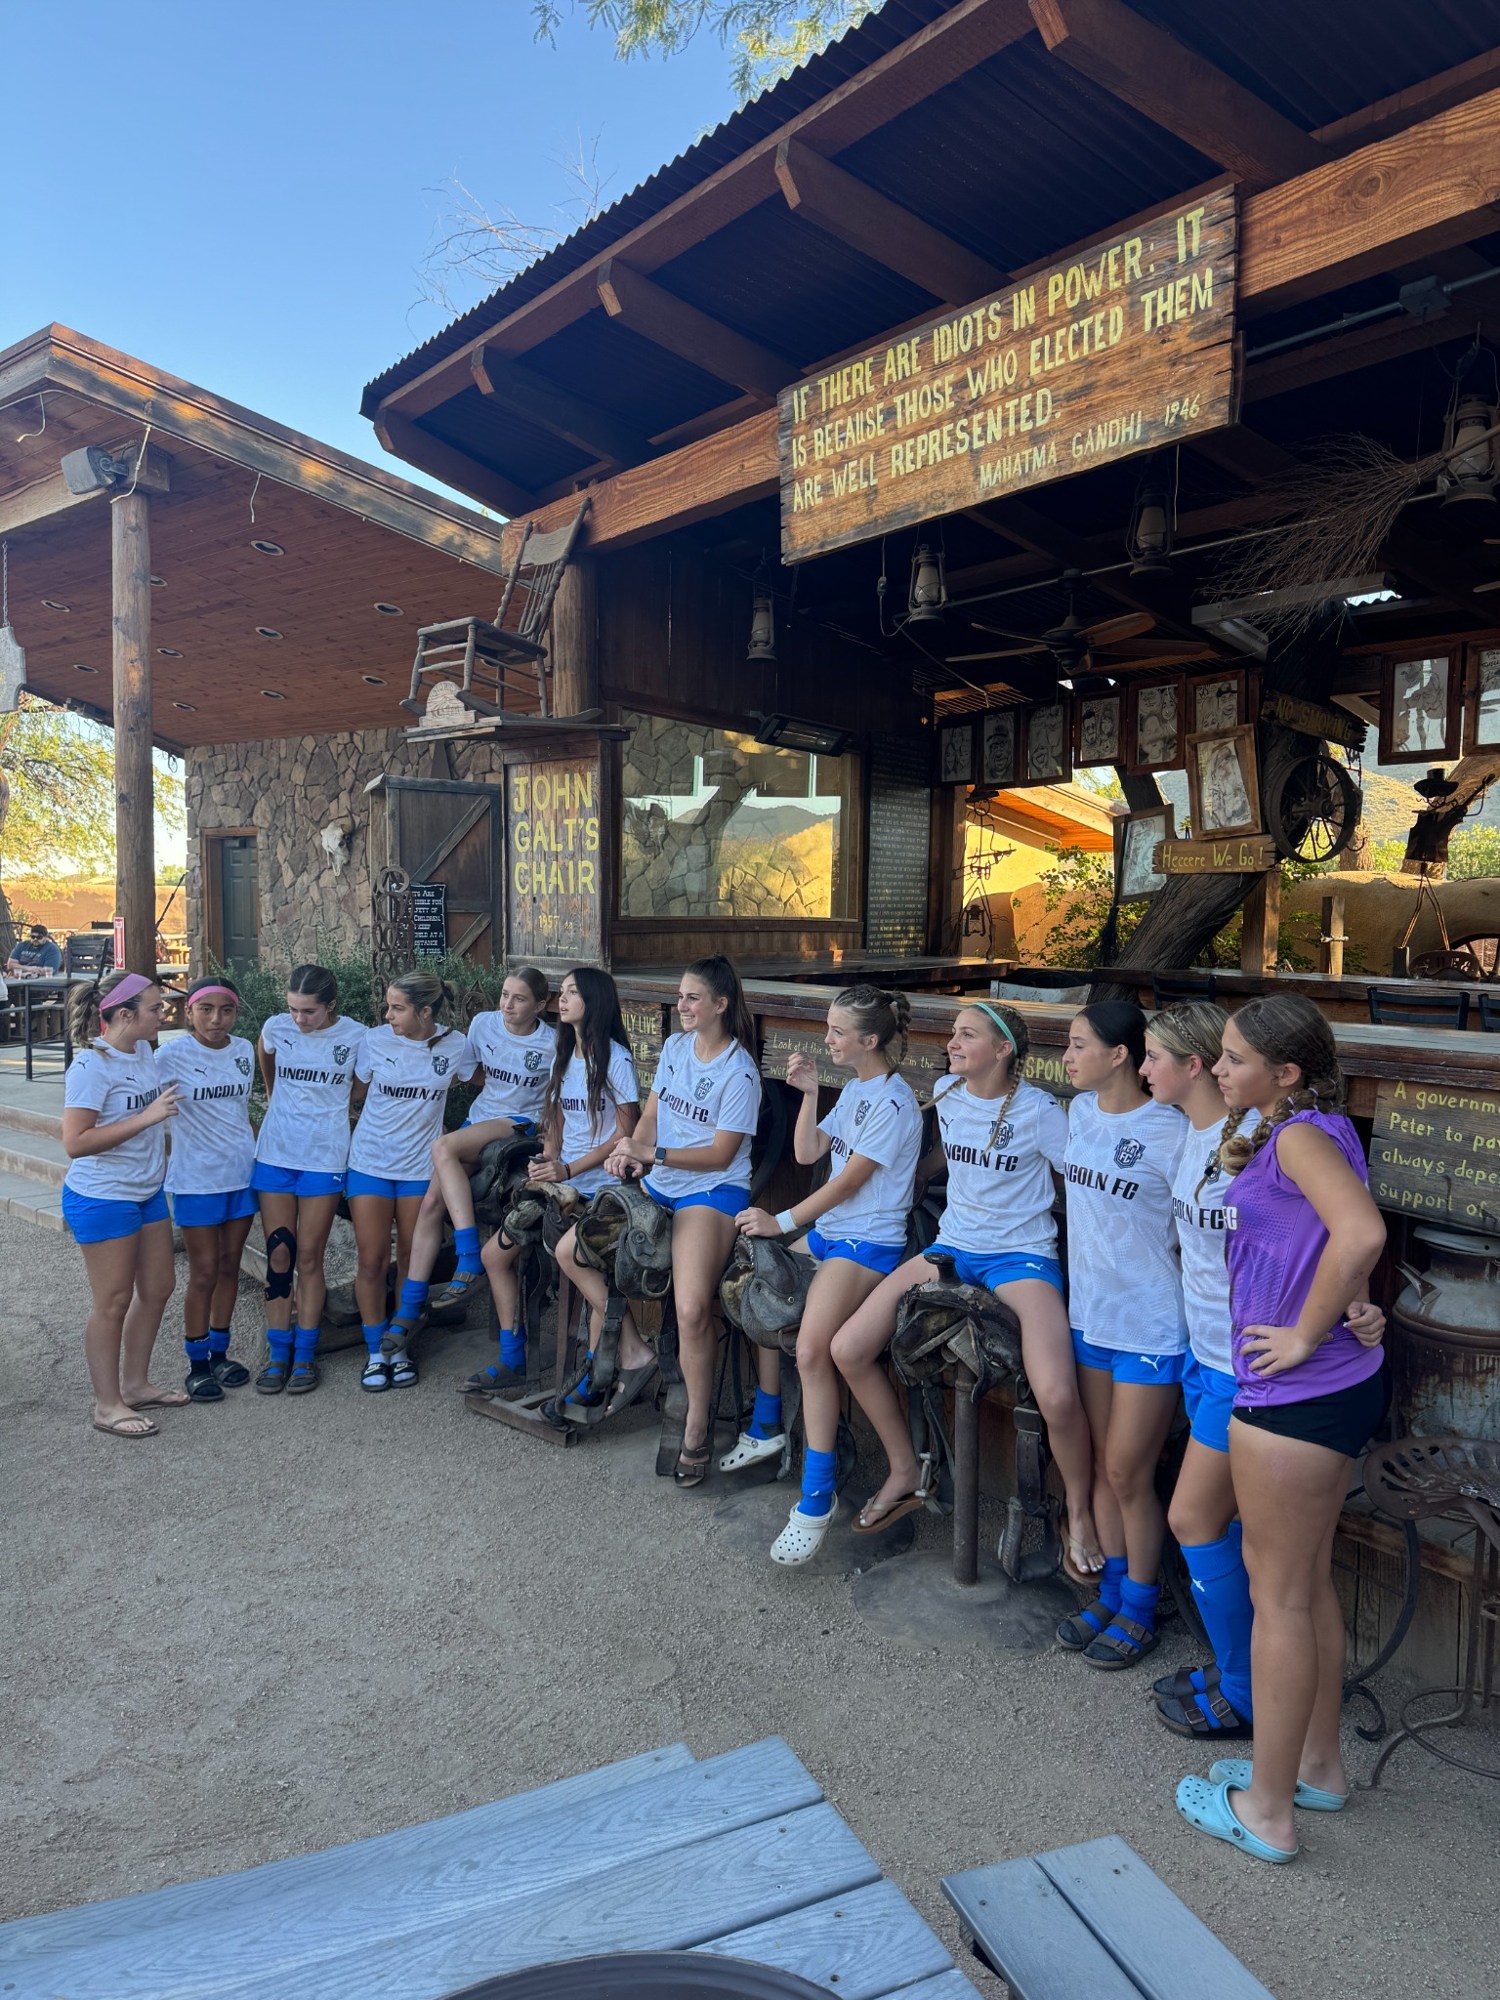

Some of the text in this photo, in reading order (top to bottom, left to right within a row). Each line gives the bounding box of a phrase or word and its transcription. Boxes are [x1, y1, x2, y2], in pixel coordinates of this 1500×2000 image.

[793, 207, 1205, 423] IF THERE ARE IDIOTS IN POWER: IT
[792, 267, 1213, 470] IS BECAUSE THOSE WHO ELECTED THEM
[793, 388, 1062, 512] ARE WELL REPRESENTED.
[979, 394, 1201, 489] MAHATMA GANDHI 1946
[1275, 698, 1353, 740] NO SMOKING
[513, 772, 593, 812] JOHN
[514, 816, 599, 853] GALT'S
[1213, 843, 1233, 866] We
[513, 860, 596, 895] CHAIR
[621, 1013, 657, 1034] NLY LIVE
[773, 1033, 792, 1050] Look
[921, 1056, 935, 1069] the
[278, 1066, 346, 1085] LINCOLN FC
[523, 1076, 539, 1087] FC
[818, 1069, 838, 1084] elow
[193, 1084, 245, 1101] LINCOLN
[379, 1083, 430, 1100] LINCOLN
[1394, 1081, 1406, 1099] A
[693, 1106, 708, 1122] FC
[1389, 1112, 1434, 1137] Peter
[1445, 1126, 1463, 1143] to
[995, 1154, 1019, 1172] FC
[1382, 1147, 1500, 1186] always depe
[1111, 1177, 1139, 1200] FC
[1379, 1183, 1488, 1218] support of
[1199, 1208, 1224, 1230] FC
